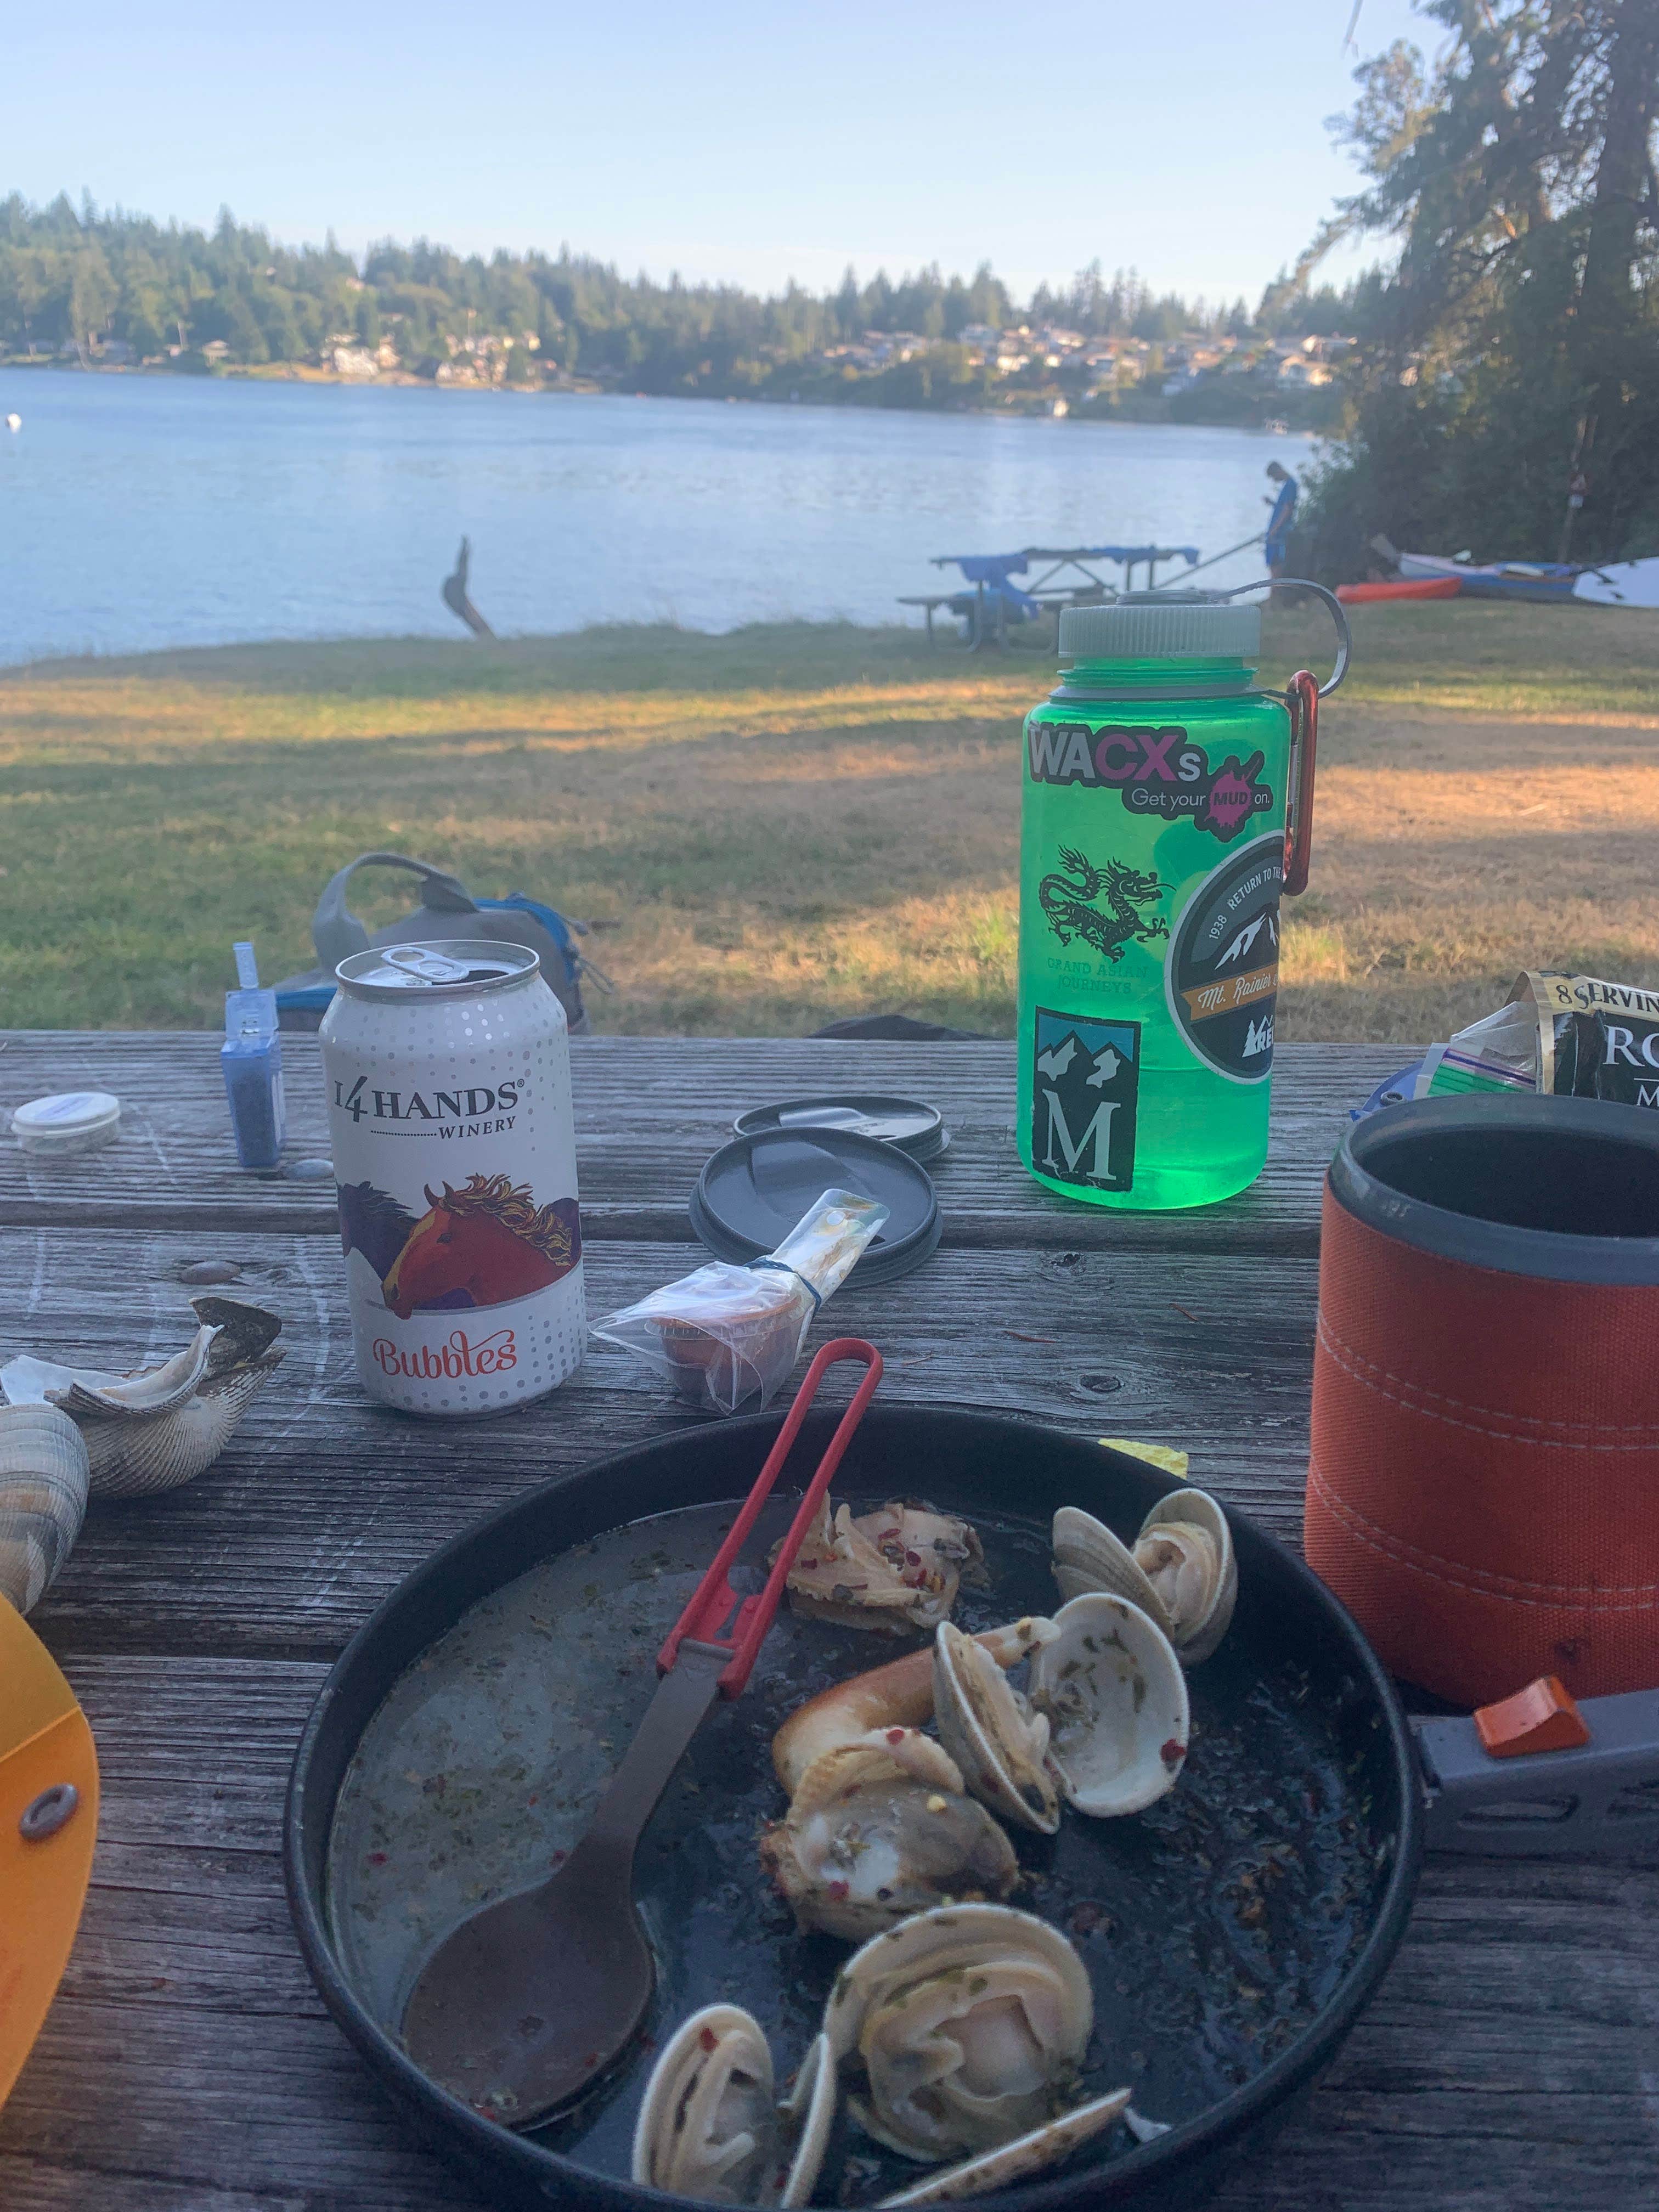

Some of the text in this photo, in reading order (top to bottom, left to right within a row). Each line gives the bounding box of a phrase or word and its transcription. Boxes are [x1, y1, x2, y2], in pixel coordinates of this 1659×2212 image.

[1030, 729, 1201, 782] WACXs
[1132, 788, 1270, 811] Get your MUD on.
[1209, 866, 1282, 939] 1938 RETURN TO THE
[1047, 957, 1149, 978] GRAND ASIAN
[1057, 974, 1132, 995] JOURNEYS
[1198, 985, 1226, 1010] Mt.
[1233, 973, 1271, 1005] Rainier
[1556, 984, 1572, 1004] 8
[334, 1076, 368, 1122] 14
[438, 1116, 516, 1139] WINERY
[1042, 1088, 1121, 1180] M
[373, 1329, 517, 1379] Bubbles
